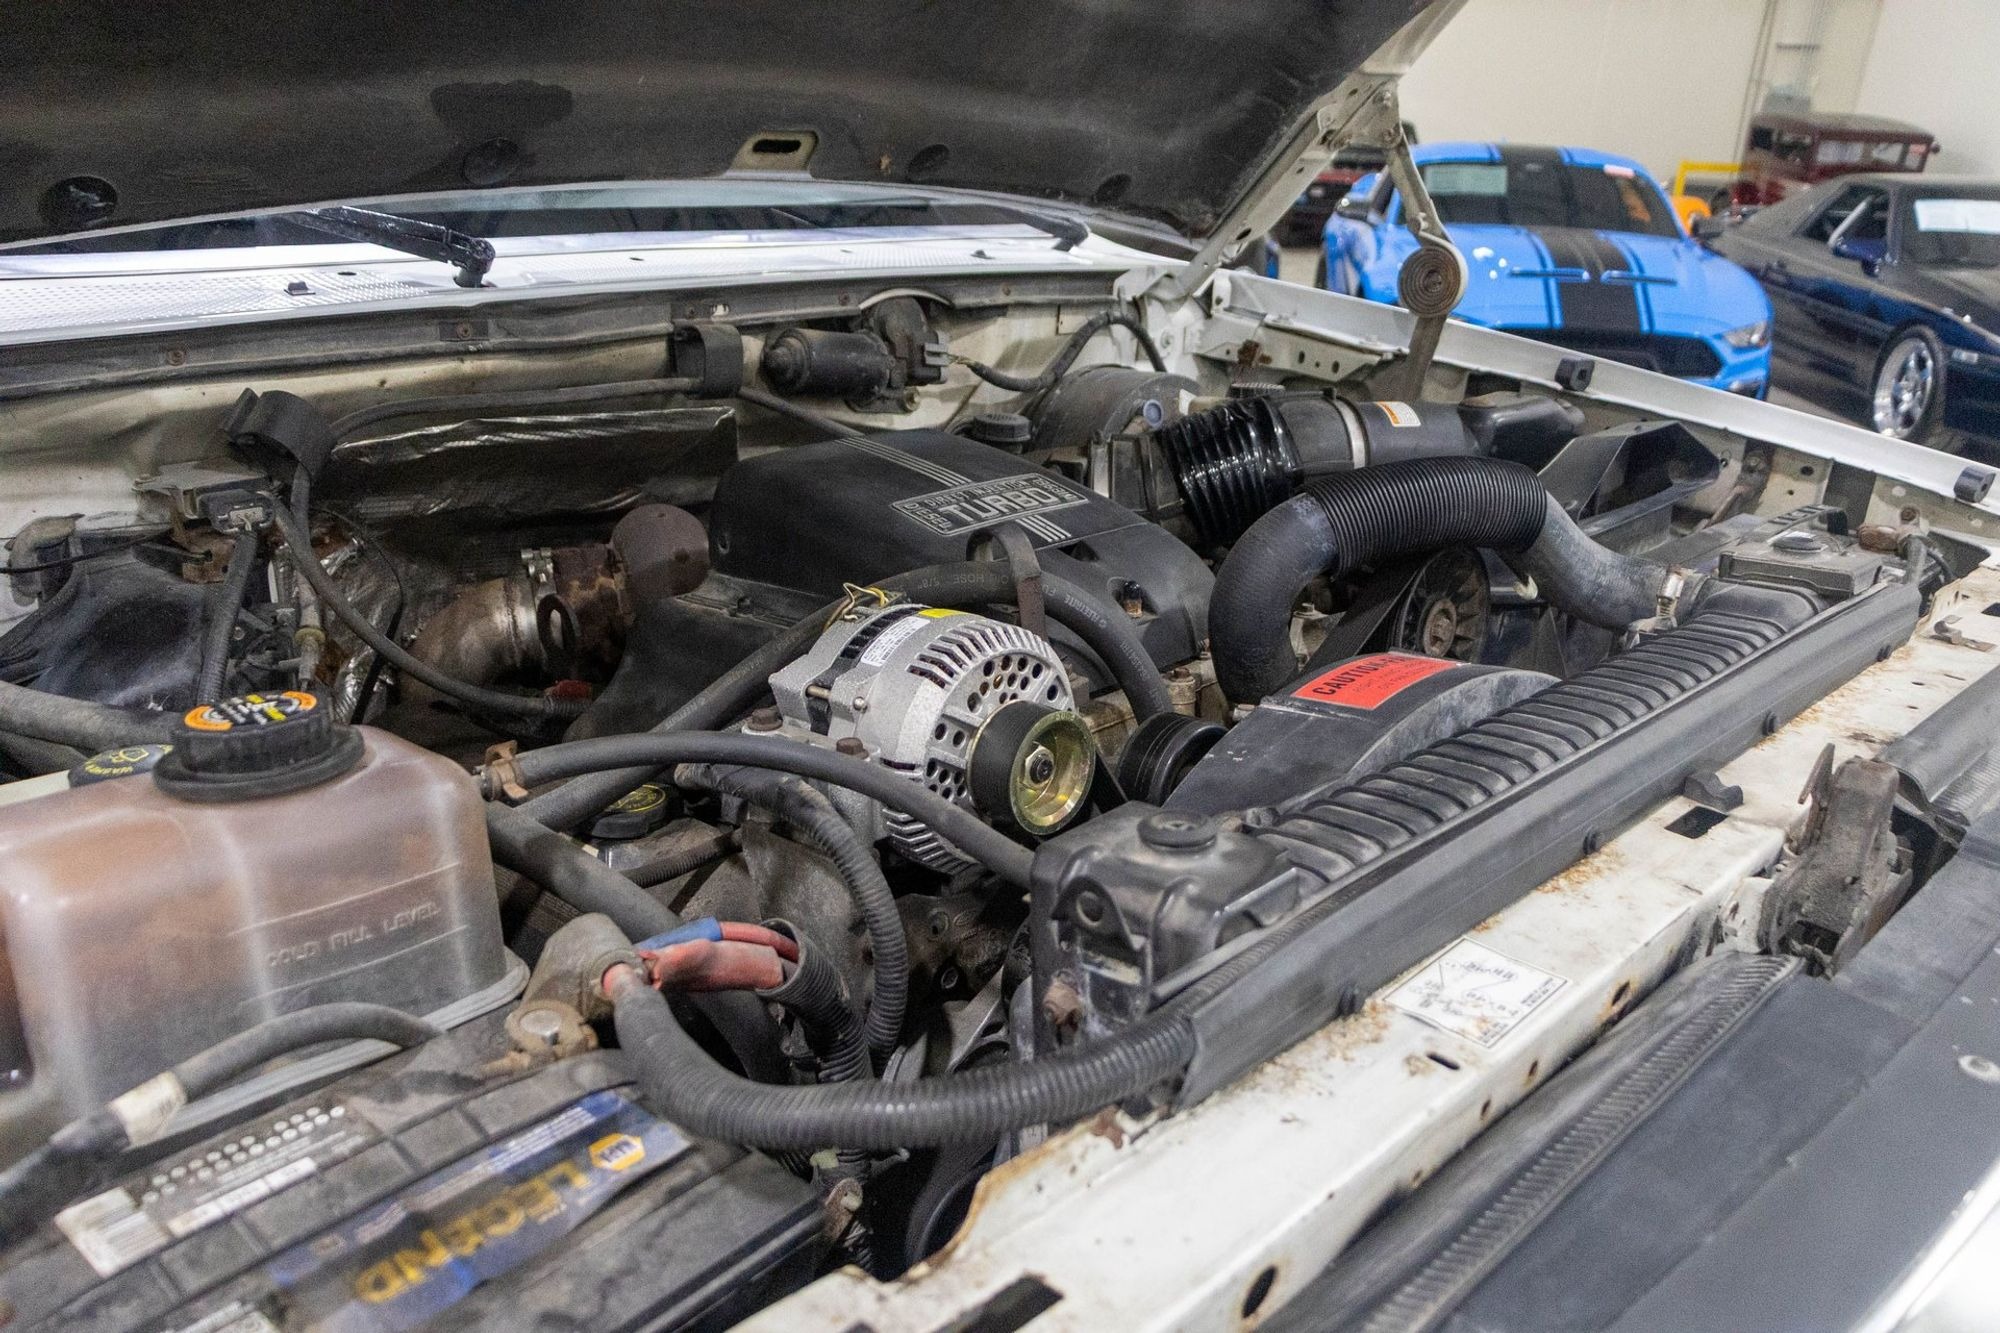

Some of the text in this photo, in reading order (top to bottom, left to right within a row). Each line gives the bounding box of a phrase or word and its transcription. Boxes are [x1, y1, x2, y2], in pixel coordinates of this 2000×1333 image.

[923, 479, 1030, 508] DIRECT INJECTION
[937, 487, 1059, 523] TURBO
[902, 503, 952, 530] DIESEL
[952, 573, 985, 585] HOSE
[329, 924, 375, 951] FILL
[382, 901, 442, 934] LEVEL
